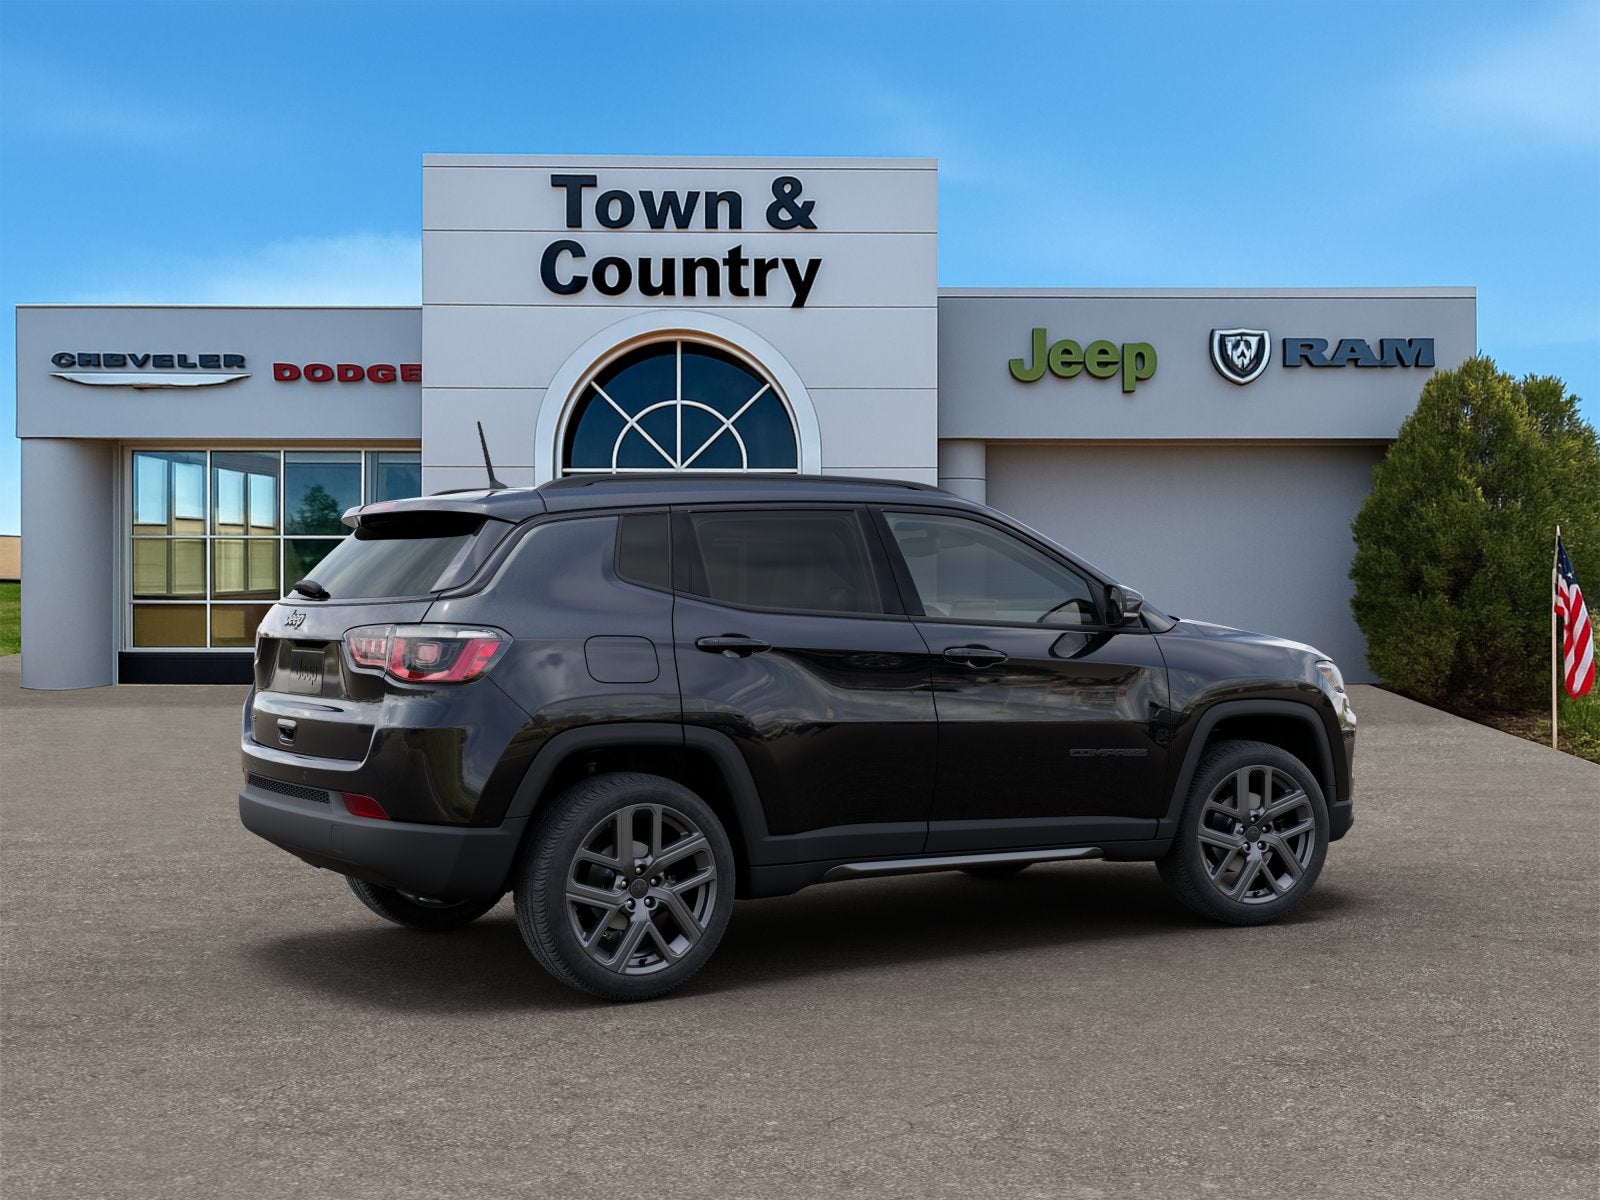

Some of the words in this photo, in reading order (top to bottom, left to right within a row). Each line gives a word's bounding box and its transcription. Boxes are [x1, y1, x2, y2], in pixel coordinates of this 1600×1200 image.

[550, 174, 743, 230] Town
[765, 176, 818, 230] &
[540, 239, 823, 308] Country
[272, 362, 422, 383] DODGE
[1008, 327, 1157, 393] Jeep
[1282, 337, 1436, 368] RAM
